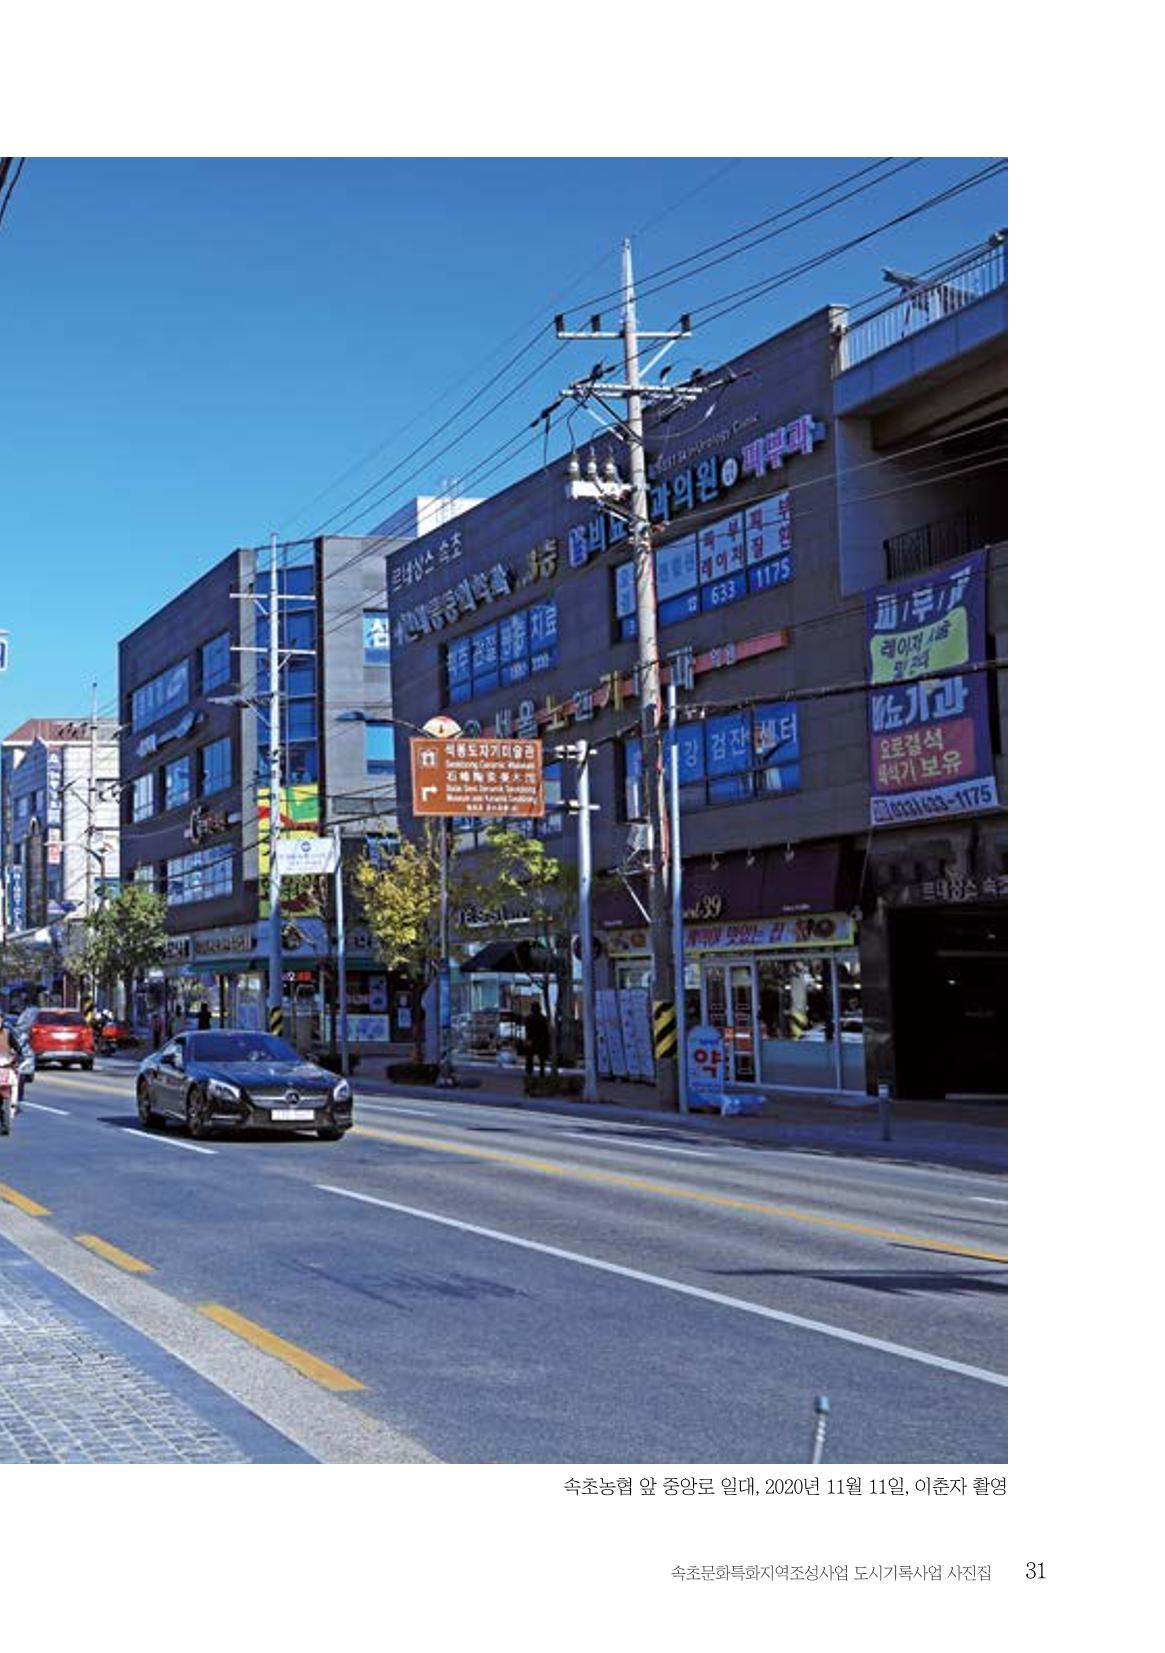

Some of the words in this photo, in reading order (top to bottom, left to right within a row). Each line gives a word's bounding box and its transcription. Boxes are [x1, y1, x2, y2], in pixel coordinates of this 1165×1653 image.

[742, 413, 815, 478] 피부과
[711, 580, 737, 605] 633
[756, 556, 792, 588] 1175
[872, 676, 970, 733] 비뇨기과
[921, 751, 963, 779] 보유
[693, 1048, 723, 1080] 약
